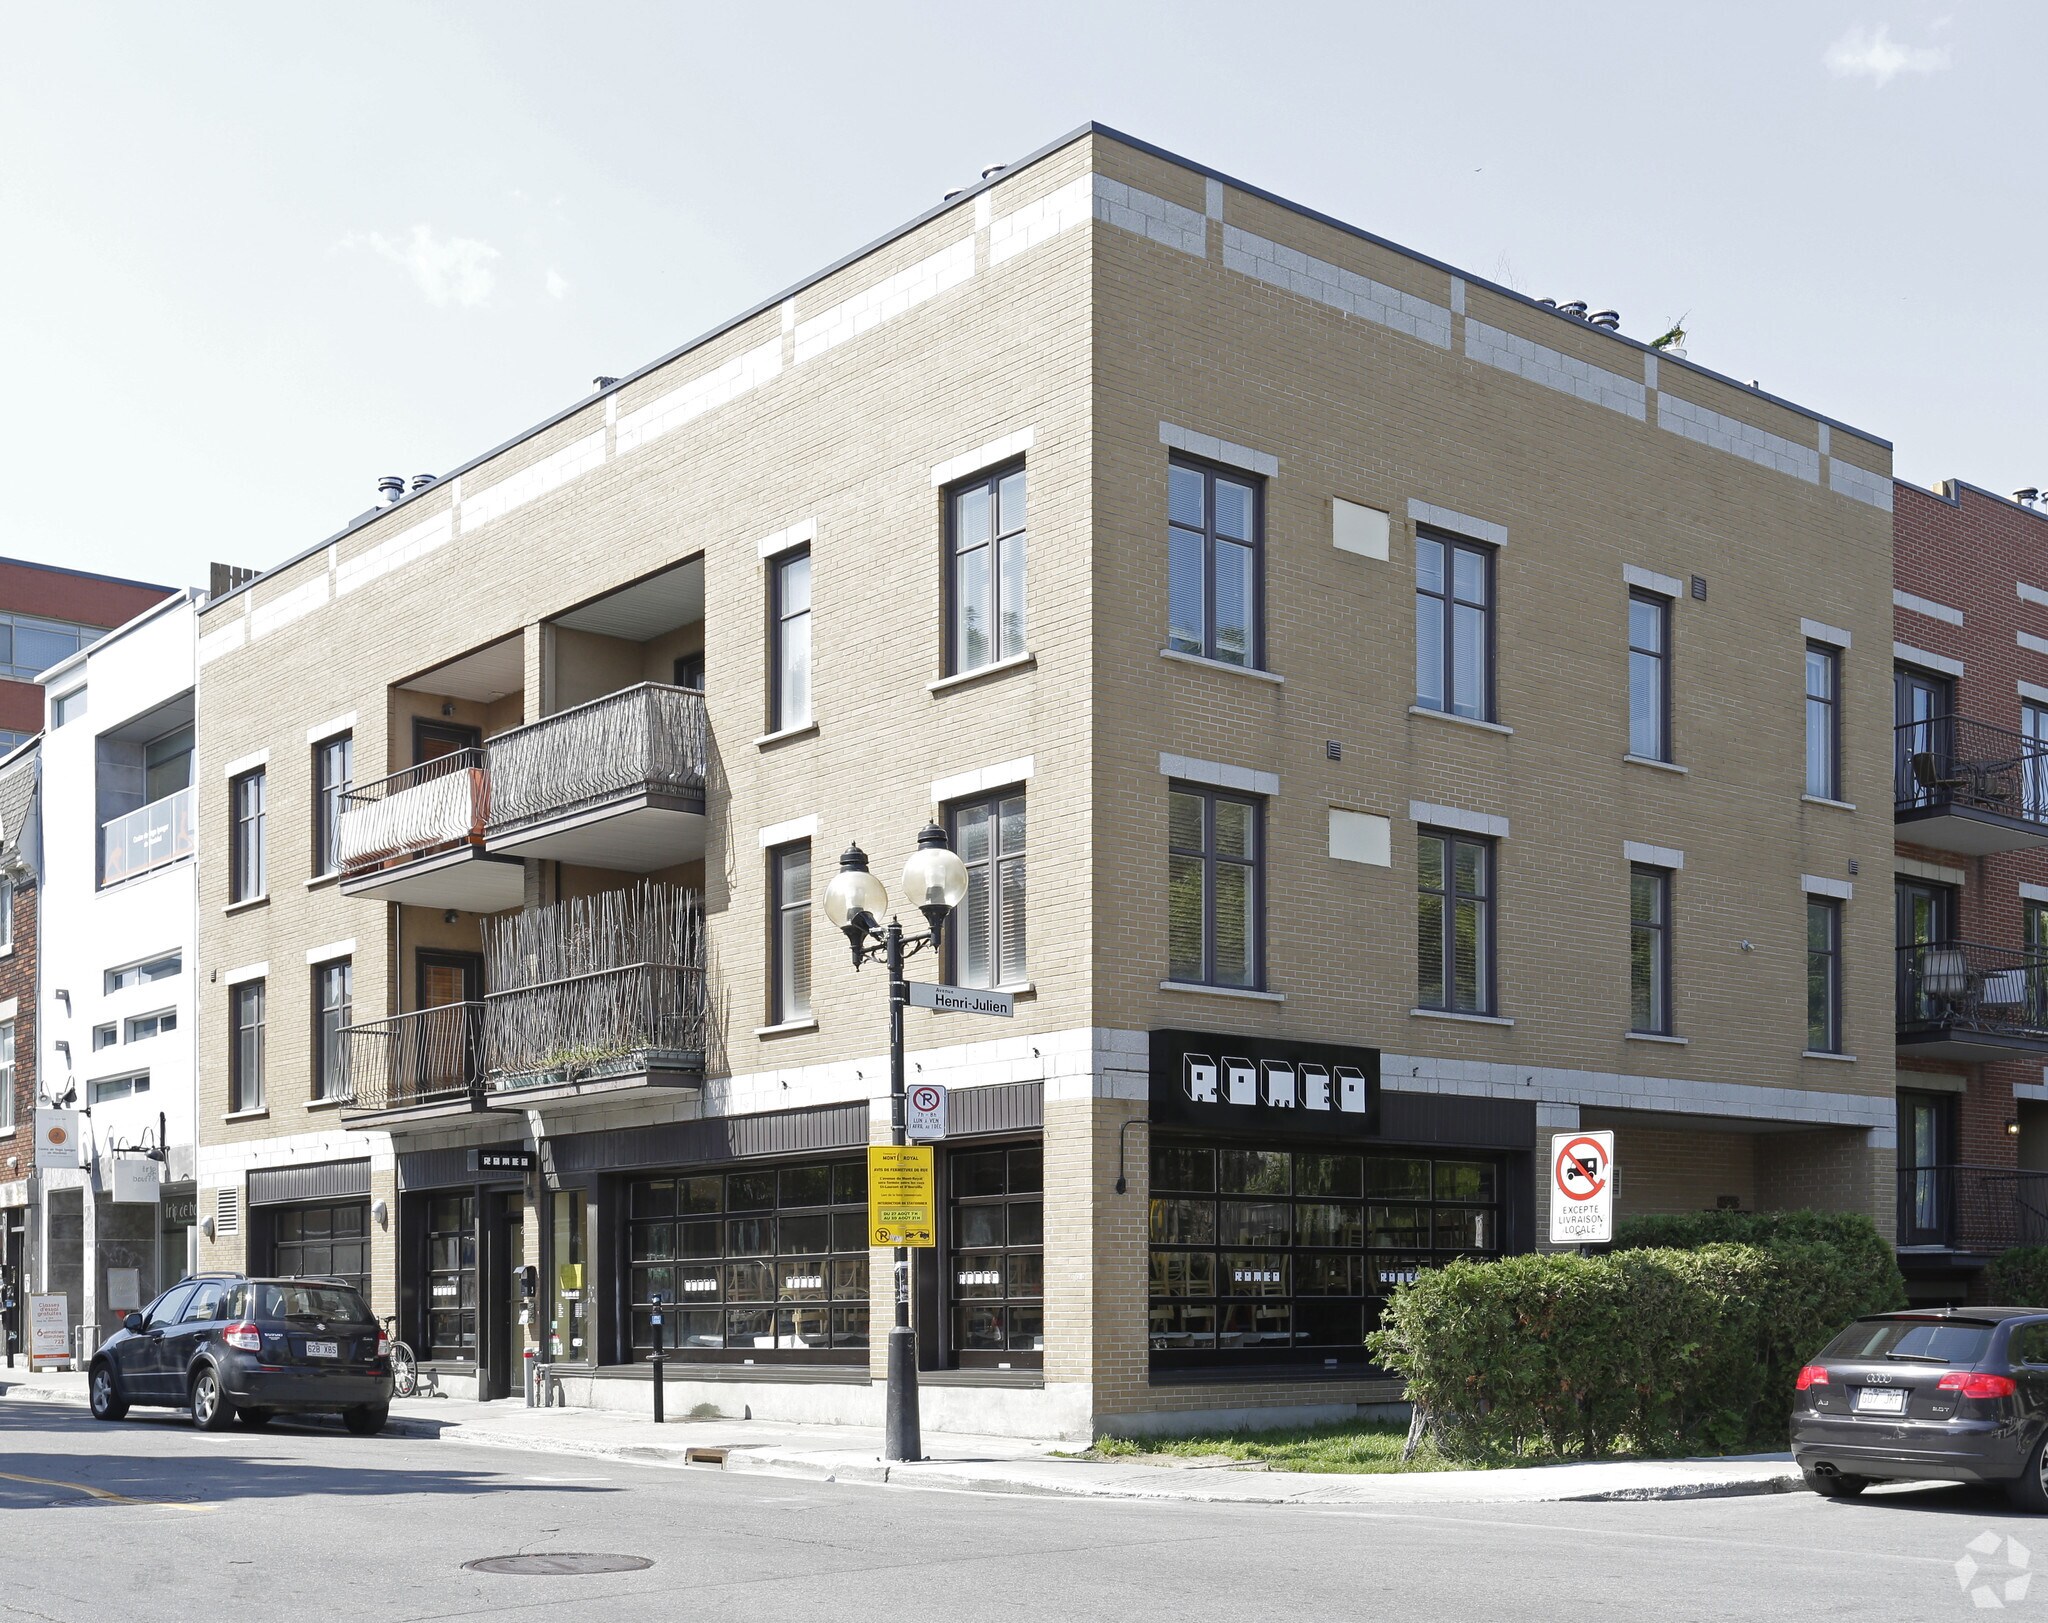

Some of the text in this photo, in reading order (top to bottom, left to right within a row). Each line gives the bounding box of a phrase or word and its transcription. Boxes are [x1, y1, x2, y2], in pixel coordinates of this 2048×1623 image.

[935, 994, 1008, 1014] Henri-Julien
[1183, 1053, 1366, 1113] ROMEO
[482, 1156, 528, 1166] ROMEO
[1558, 1215, 1603, 1224] LIVRAISON
[1564, 1225, 1596, 1234] LOCALE
[1234, 1269, 1280, 1282] ROMEO
[308, 1344, 336, 1354] 628 XBS
